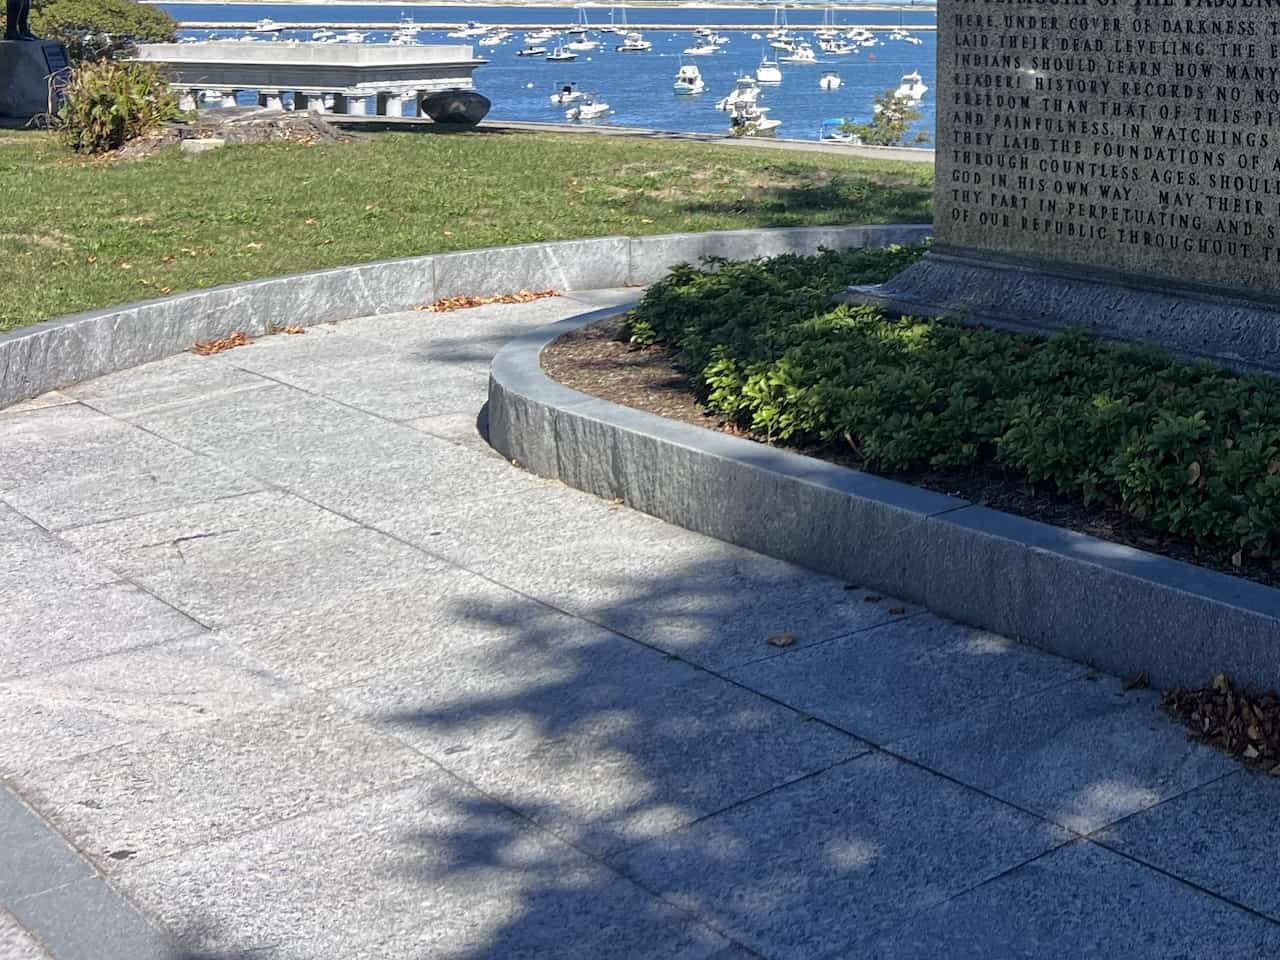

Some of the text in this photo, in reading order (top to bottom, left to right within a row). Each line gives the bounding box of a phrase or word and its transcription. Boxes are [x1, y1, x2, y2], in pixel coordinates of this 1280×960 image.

[1004, 14, 1059, 30] UNDER
[1068, 16, 1122, 32] COVER
[1131, 17, 1152, 32] OF
[998, 34, 1049, 50] THEIR
[1219, 41, 1255, 58] THE
[953, 52, 1021, 69] INDIANS
[1031, 55, 1096, 73] SHOULD
[1106, 59, 1161, 76] LEARN
[1174, 62, 1212, 78] HOW
[1225, 64, 1277, 82] MANY
[1034, 76, 1109, 95] HISTORY
[1121, 81, 1204, 100] RECORDS
[1216, 86, 1241, 103] NO
[953, 91, 1030, 110] FREEDOM
[1041, 96, 1088, 114] THAN
[1099, 100, 1147, 118] THAT
[1158, 104, 1182, 121] OF
[1192, 106, 1241, 125] THIS
[952, 110, 984, 126] AND
[1121, 122, 1140, 139] IN
[1151, 125, 1269, 150] WATCHINGS
[952, 129, 994, 146] THEY
[1049, 137, 1082, 155] THE
[1093, 141, 1225, 168] FOUNDATIONS
[1237, 153, 1259, 171] OF
[952, 149, 1029, 171] THROUGH
[951, 168, 982, 185] GOD
[991, 172, 1008, 188] IN
[1017, 175, 1046, 193] HIS
[1052, 179, 1089, 197] OWN
[1158, 190, 1194, 210] MAY
[1205, 195, 1265, 218] THEIR
[951, 187, 981, 205] THY
[990, 192, 1029, 211] PART
[1038, 197, 1057, 214] IN
[1067, 201, 1202, 232] PERPETUATING
[1215, 218, 1253, 239] AND
[951, 207, 970, 222] OF
[978, 210, 1010, 228] OUR
[1020, 215, 1107, 241] REPUBLIC
[1116, 228, 1253, 260] THROUGHOUT
